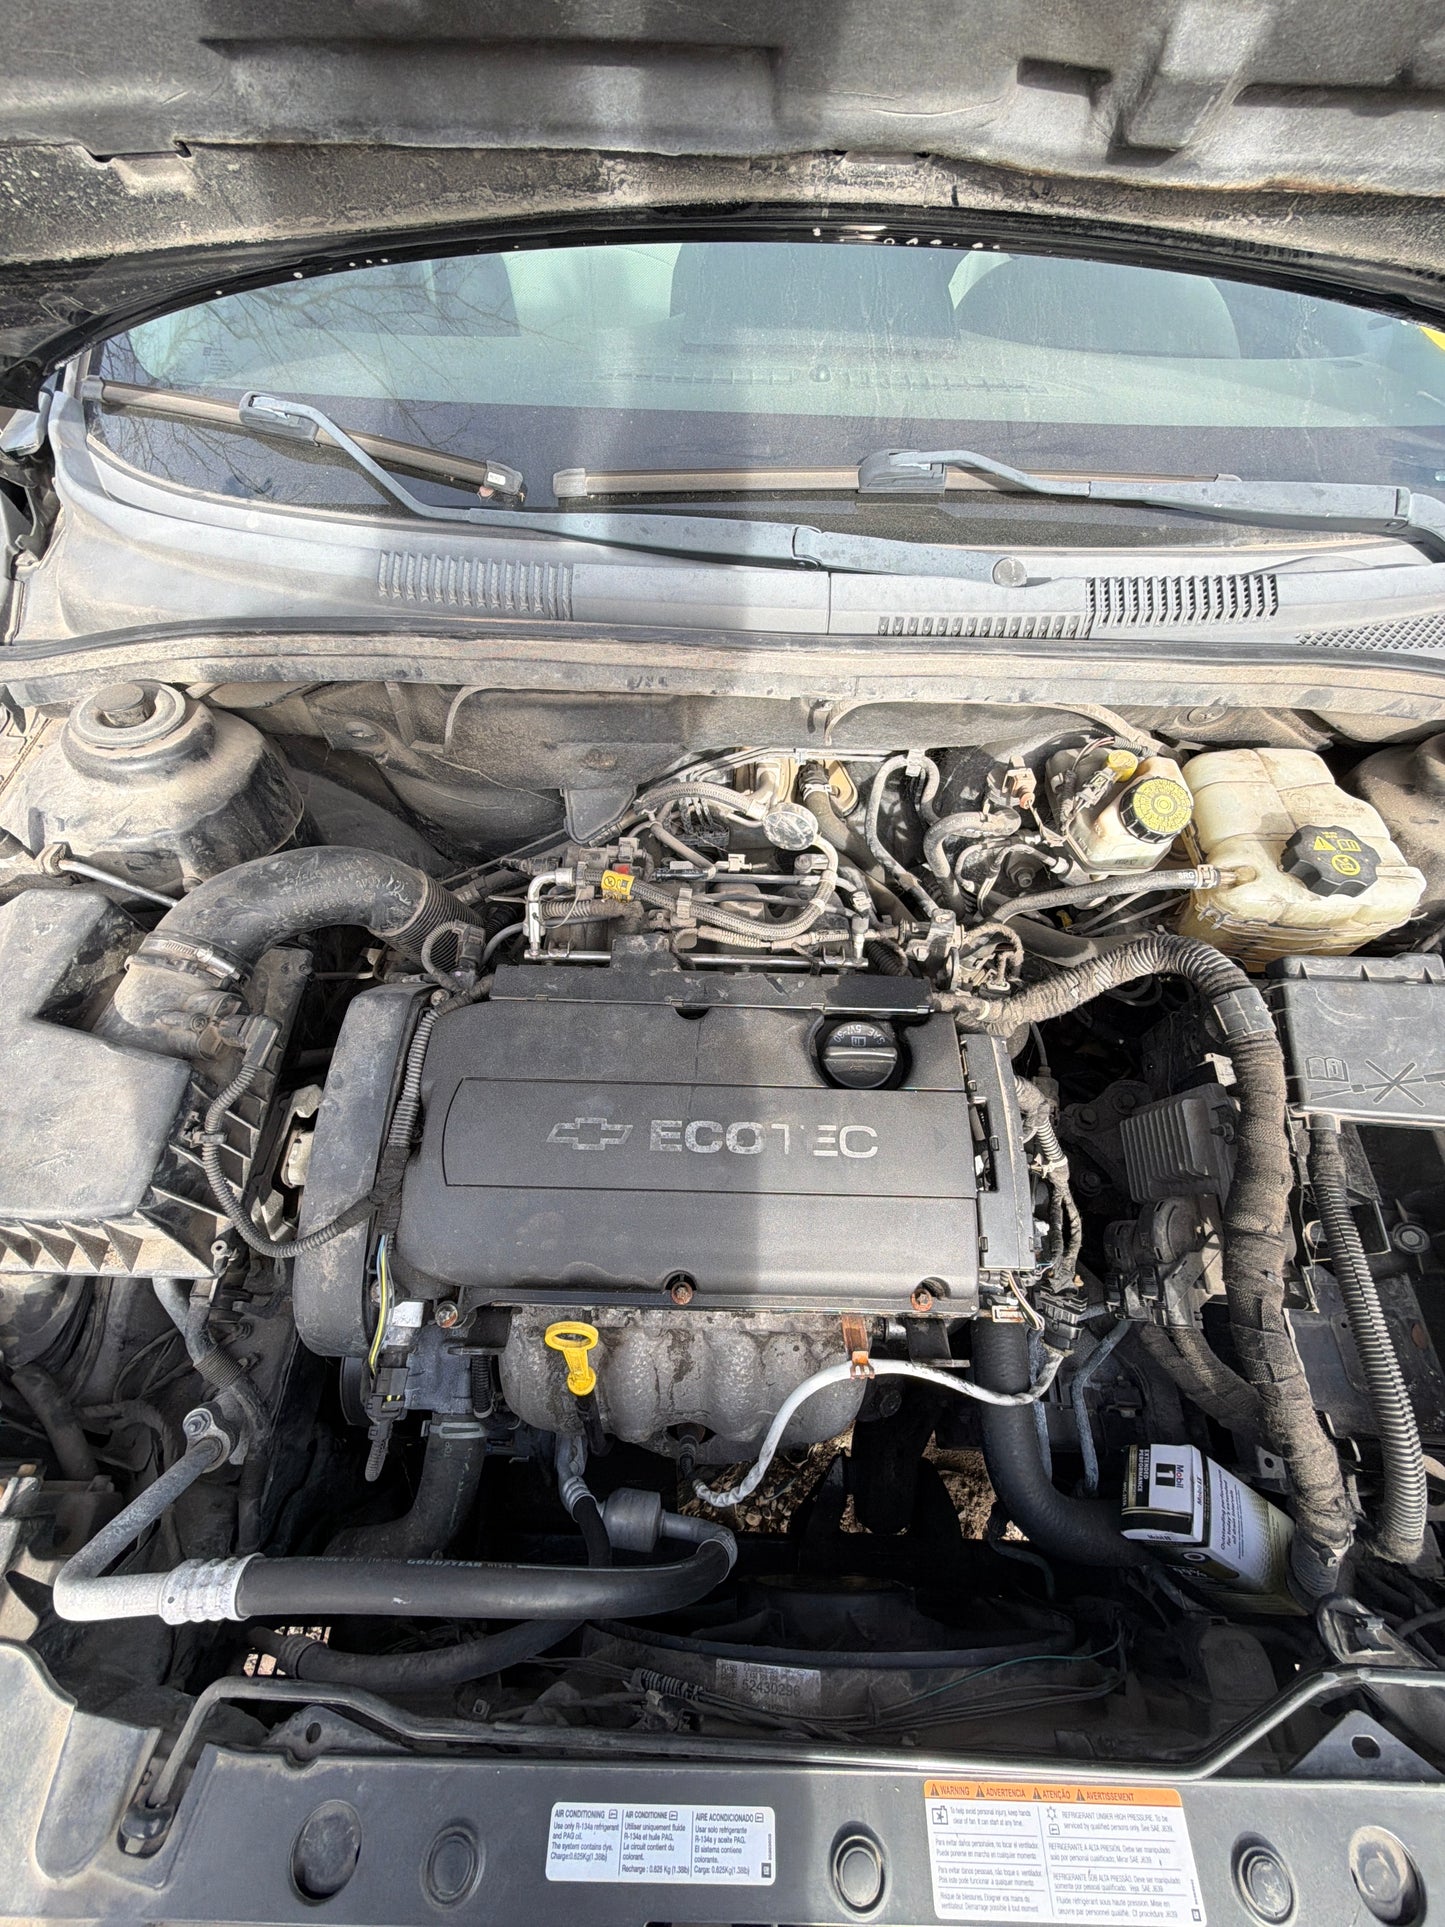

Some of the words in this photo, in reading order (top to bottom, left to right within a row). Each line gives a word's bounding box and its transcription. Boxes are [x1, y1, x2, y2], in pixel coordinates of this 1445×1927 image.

[867, 1027, 886, 1044] SAE
[650, 1119, 879, 1159] ECOTEC
[1176, 1464, 1184, 1489] Mobil
[407, 1559, 483, 1568] GOODYEAR
[742, 1679, 801, 1697] 52430296
[941, 1786, 969, 1796] WARNING
[986, 1787, 1025, 1797] ADVERTENCIA
[1087, 1792, 1134, 1801] AVERTISSEMENT
[565, 1810, 605, 1818] CONDITIONING
[696, 1813, 708, 1821] AIRE
[709, 1813, 753, 1822] ACONDICIONADO
[564, 1823, 574, 1831] only
[625, 1822, 641, 1830] Utiliser
[643, 1823, 671, 1831] uniquement
[562, 1843, 579, 1851] system
[622, 1864, 645, 1874] Recharge
[664, 1866, 671, 1874] Kg
